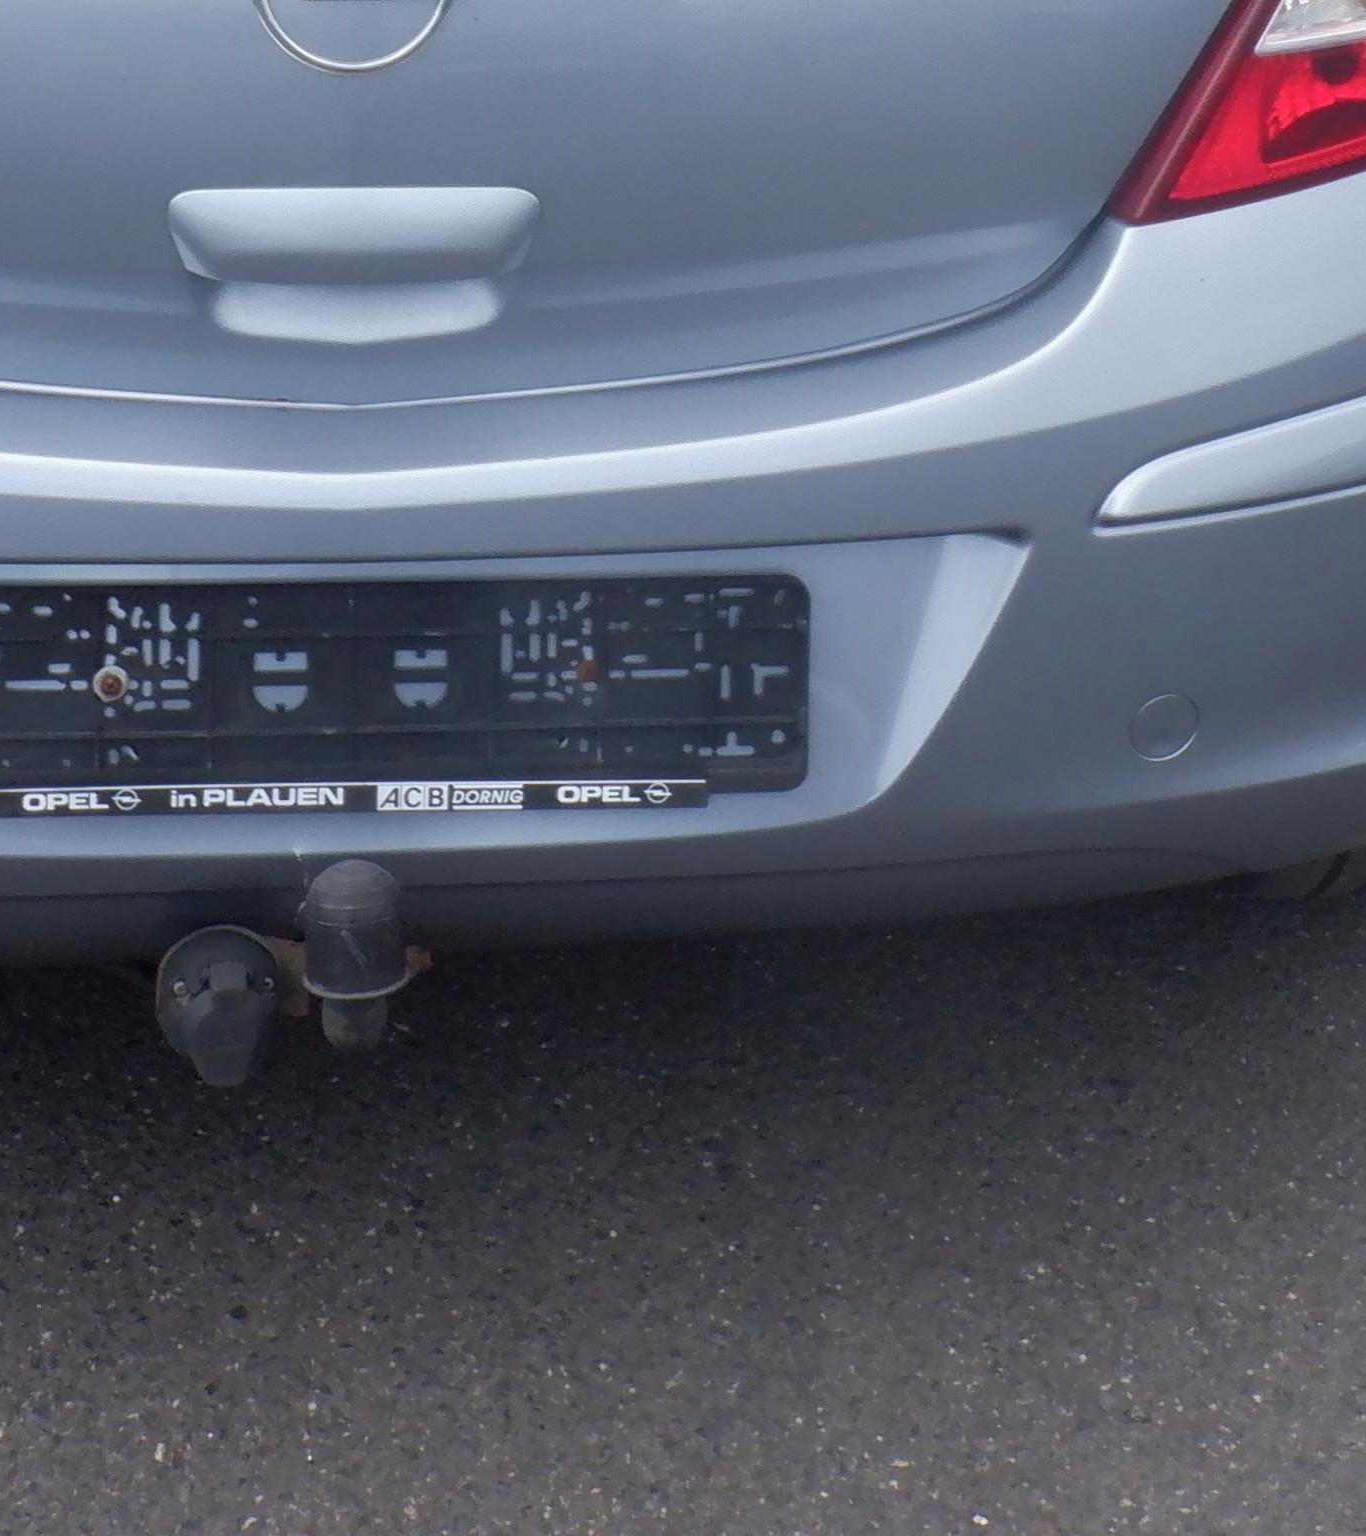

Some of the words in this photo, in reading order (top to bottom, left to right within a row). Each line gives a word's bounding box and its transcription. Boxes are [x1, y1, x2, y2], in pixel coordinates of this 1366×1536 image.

[22, 792, 110, 812] OPEL
[169, 790, 197, 809] in
[202, 787, 345, 807] PLAUEN
[380, 786, 446, 808] ACB
[452, 788, 524, 805] DORNIG
[556, 785, 641, 804] OPEL
